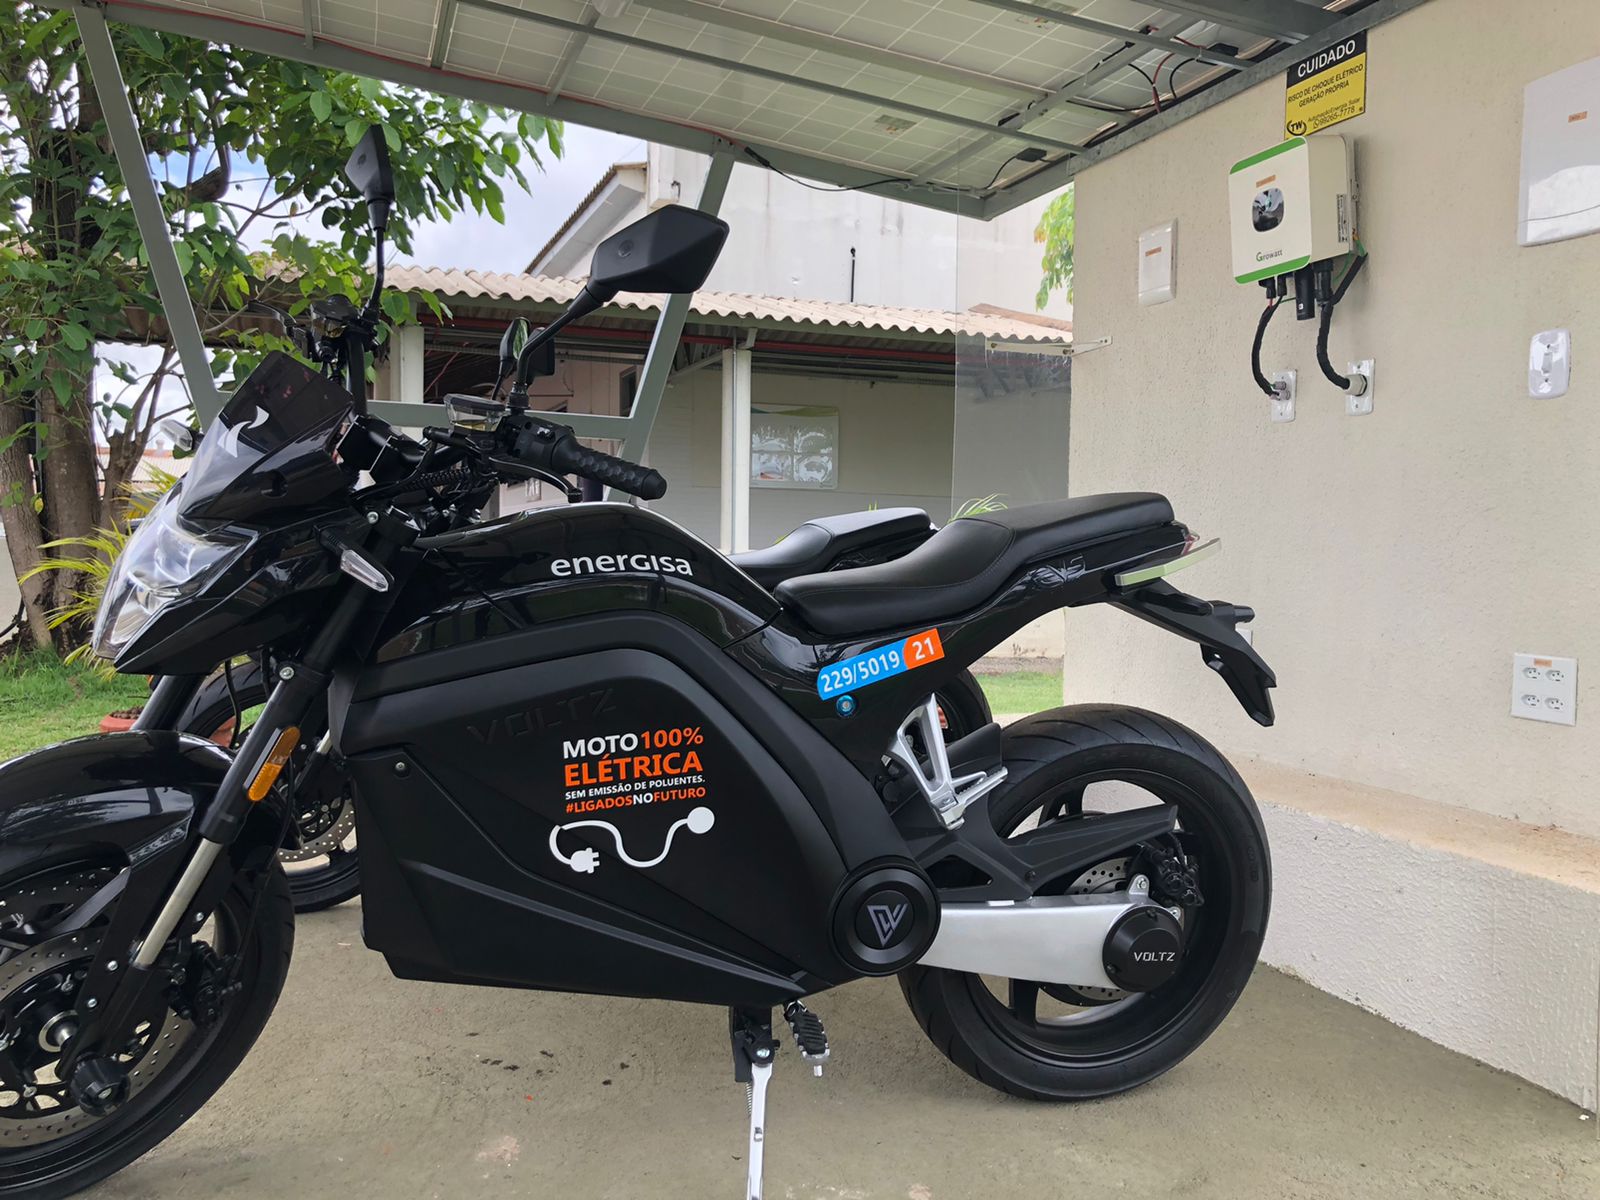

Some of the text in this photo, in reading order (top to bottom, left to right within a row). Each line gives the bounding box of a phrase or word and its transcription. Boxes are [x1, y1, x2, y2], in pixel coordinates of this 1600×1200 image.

[1297, 39, 1356, 77] CUIDADO
[1288, 64, 1364, 103] RISCO DE CHOQUE ELÉTRICO
[1298, 80, 1350, 107] GERAÇÃO PRÓPRIA
[1255, 249, 1283, 262] Growatt
[820, 637, 935, 693] 229/5019 21
[466, 688, 617, 745] VOLTZ
[562, 727, 704, 759] MOTO 100%
[564, 751, 704, 788] ELÉTRICA
[565, 774, 706, 801] SEM EMISSÃO DE POLUENTES.
[1133, 951, 1176, 962] VOLTZ
